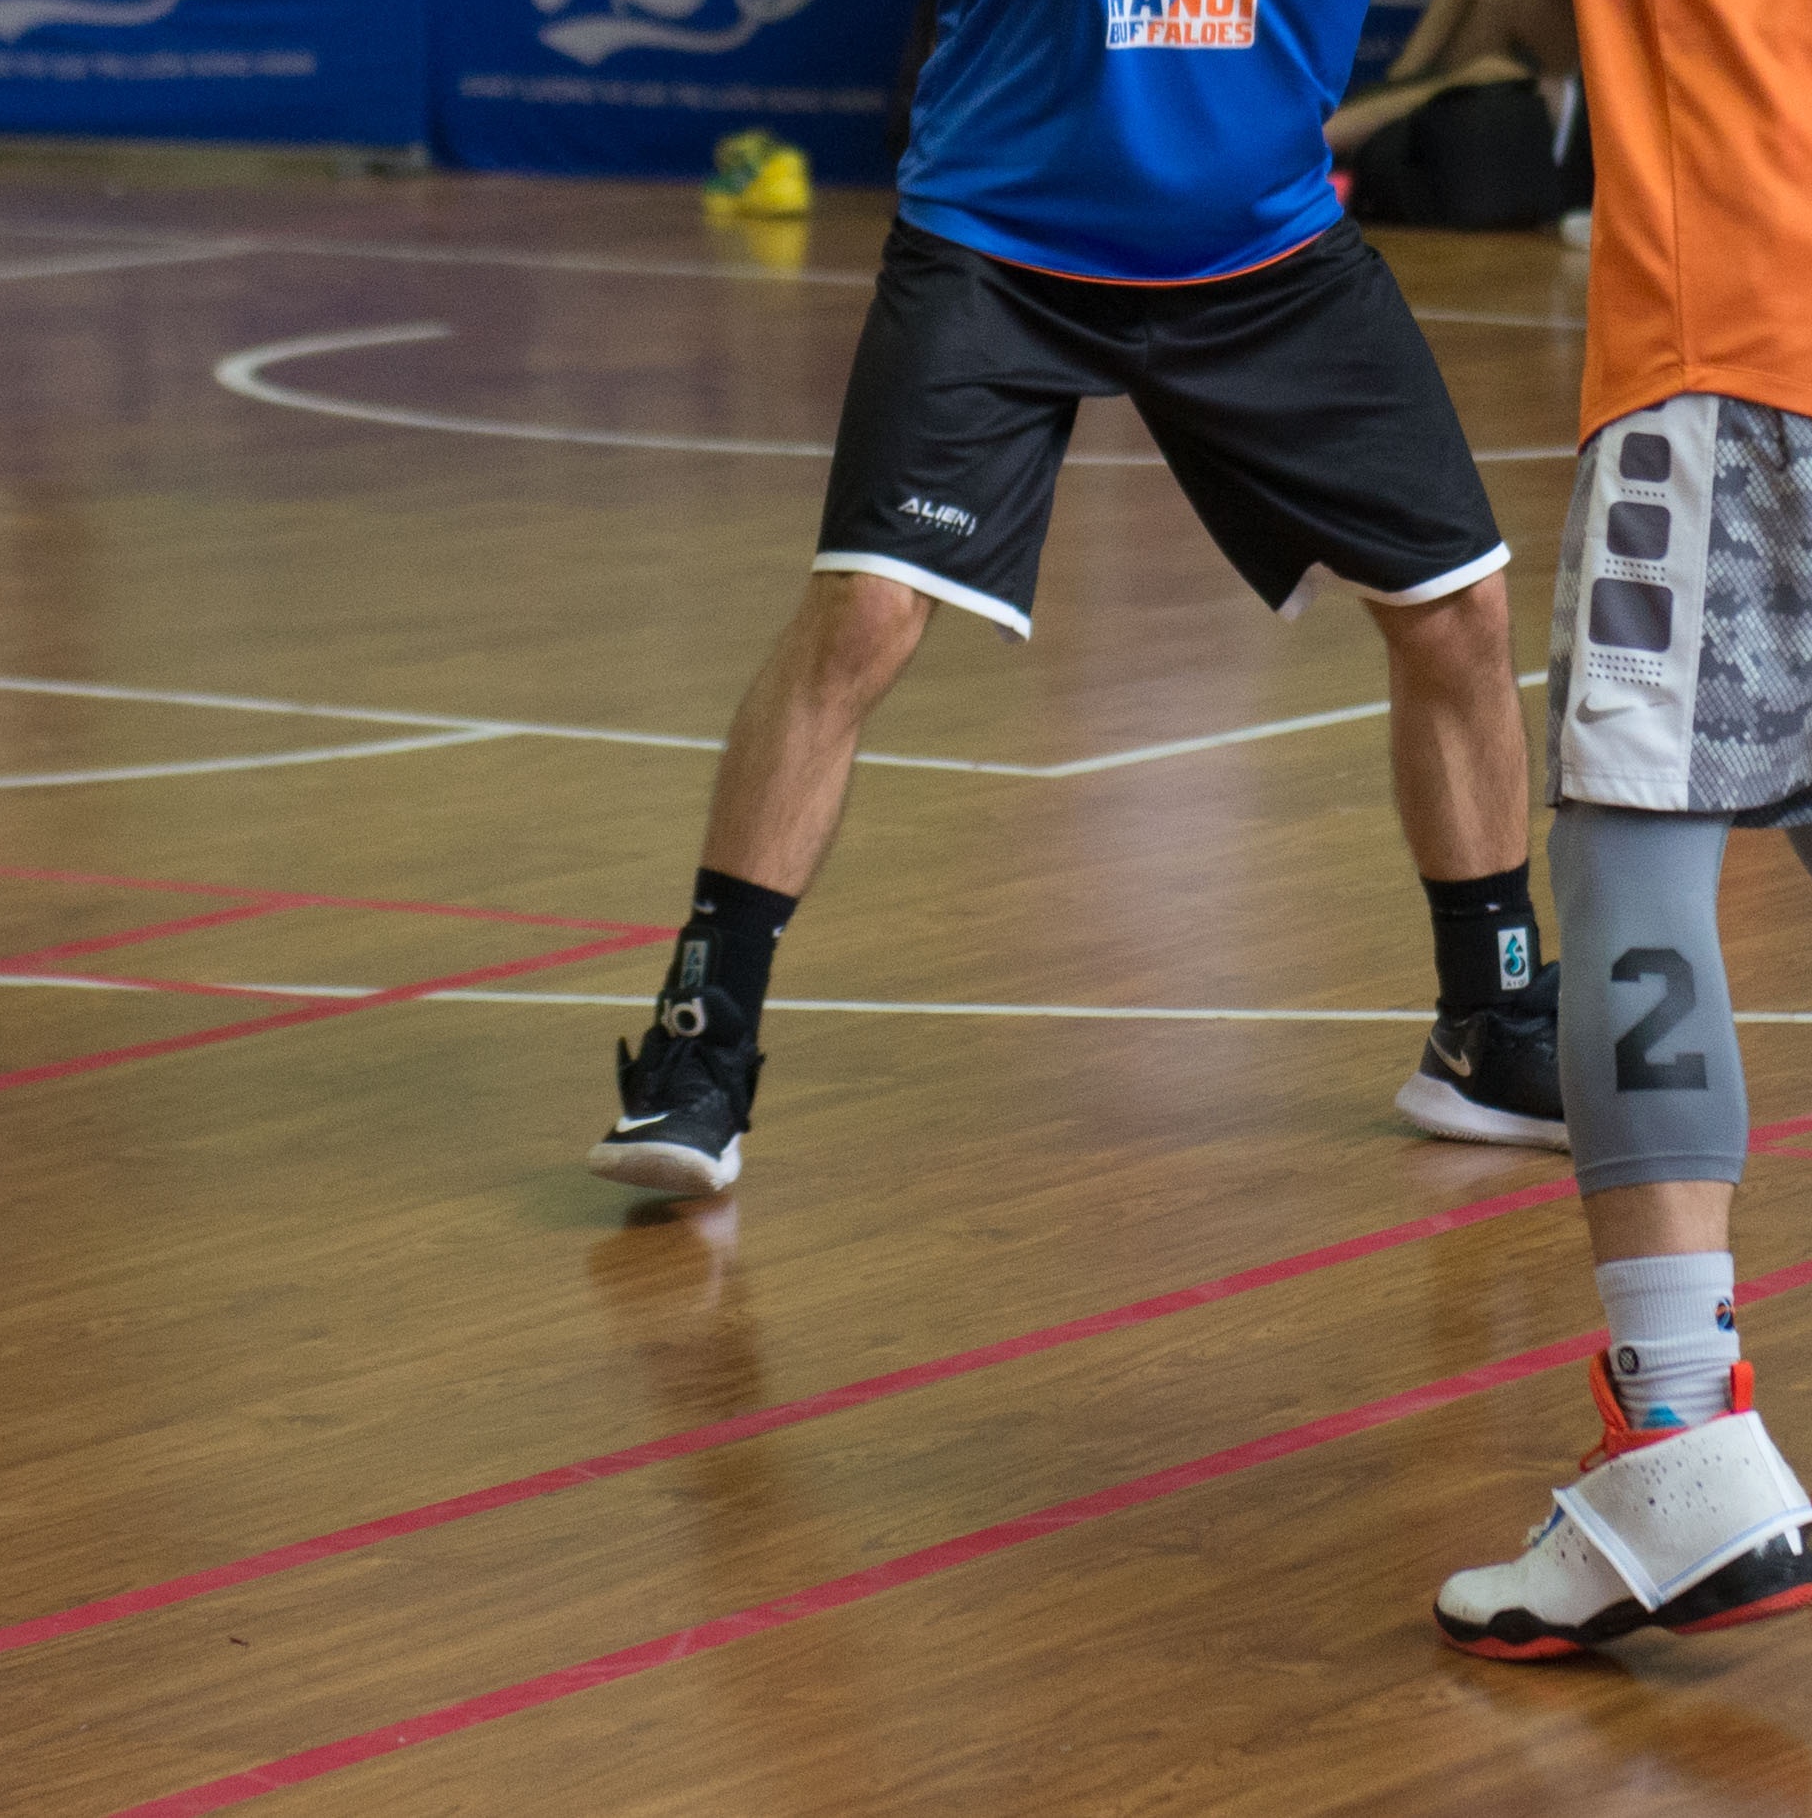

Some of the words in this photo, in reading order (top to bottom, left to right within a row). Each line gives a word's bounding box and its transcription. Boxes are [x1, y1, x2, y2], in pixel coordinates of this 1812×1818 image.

[1108, 18, 1252, 45] BUFFALOES
[898, 496, 970, 528] ALIEN
[1610, 947, 1709, 1092] 2
